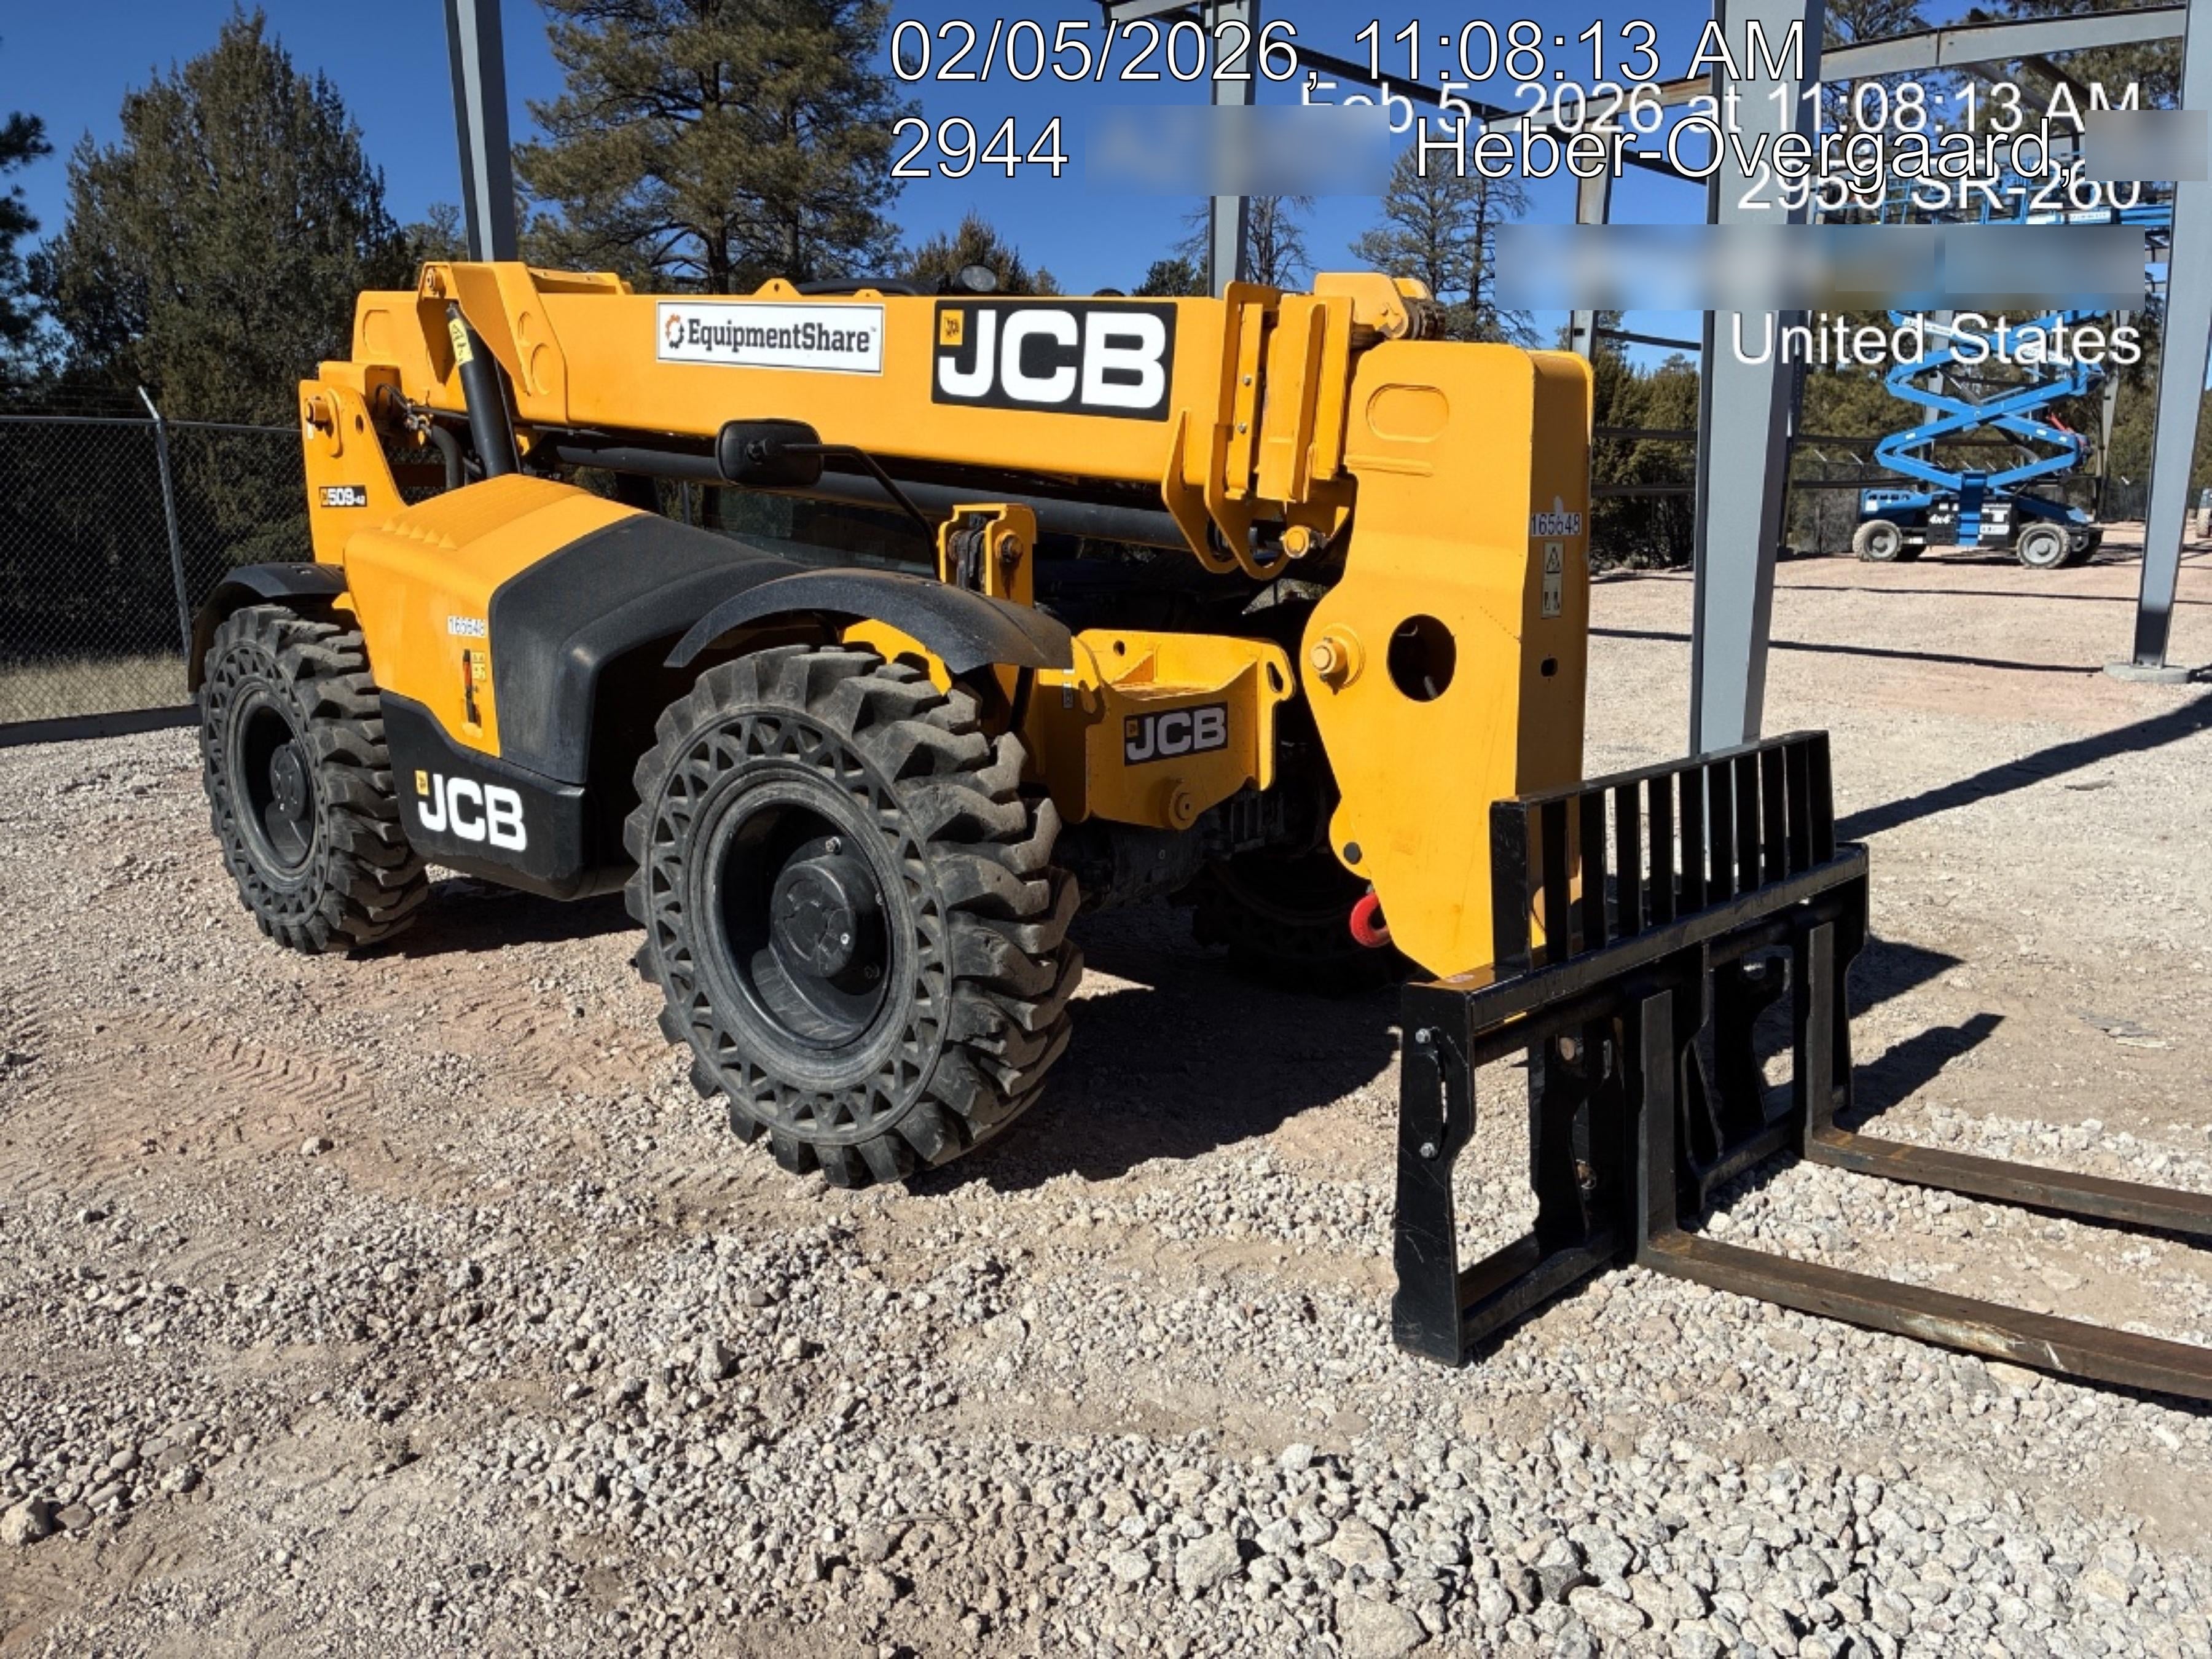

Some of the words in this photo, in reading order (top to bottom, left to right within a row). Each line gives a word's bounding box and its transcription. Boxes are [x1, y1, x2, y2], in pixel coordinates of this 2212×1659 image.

[688, 318, 870, 353] EquipmentShare
[938, 308, 1166, 409] JCB
[1532, 513, 1581, 535] 165648
[1126, 708, 1226, 761] JCB
[418, 774, 528, 852] JCB
